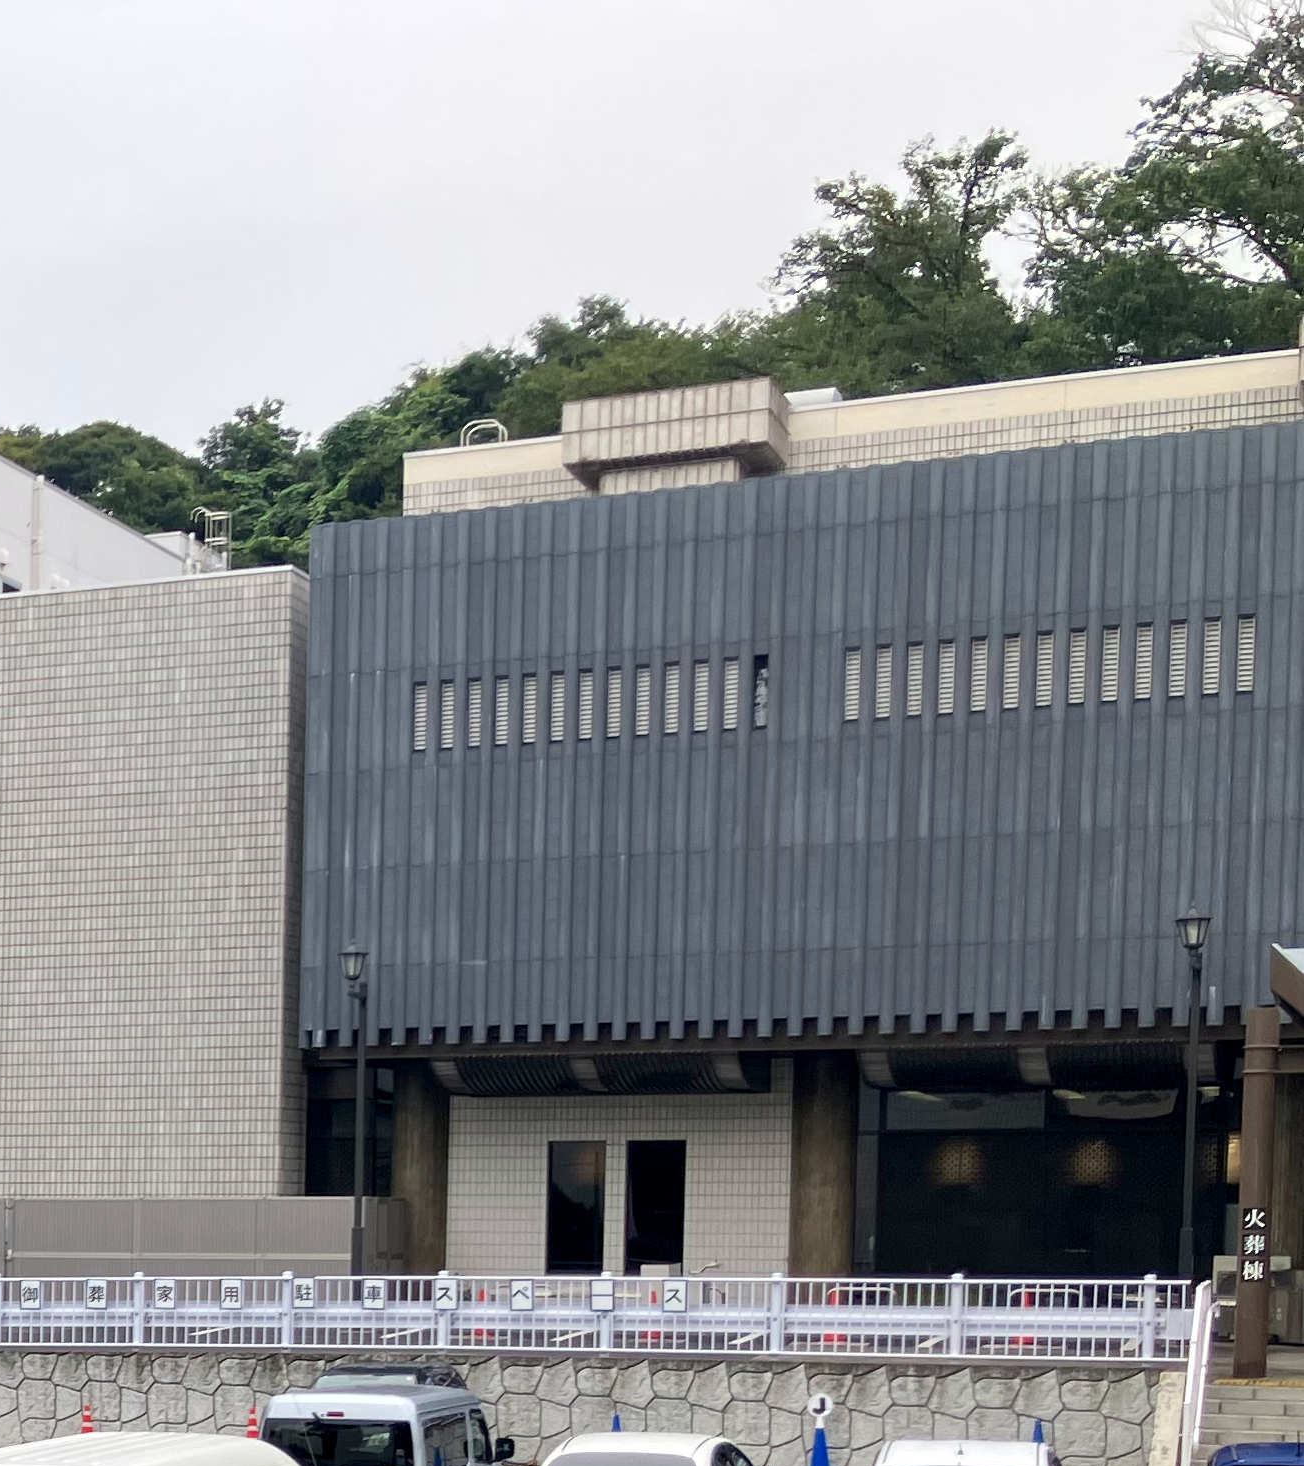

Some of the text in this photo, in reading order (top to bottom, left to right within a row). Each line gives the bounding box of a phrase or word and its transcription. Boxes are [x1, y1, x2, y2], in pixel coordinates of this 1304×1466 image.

[1243, 1208, 1266, 1281] 火葬棟
[812, 1397, 826, 1414] J
